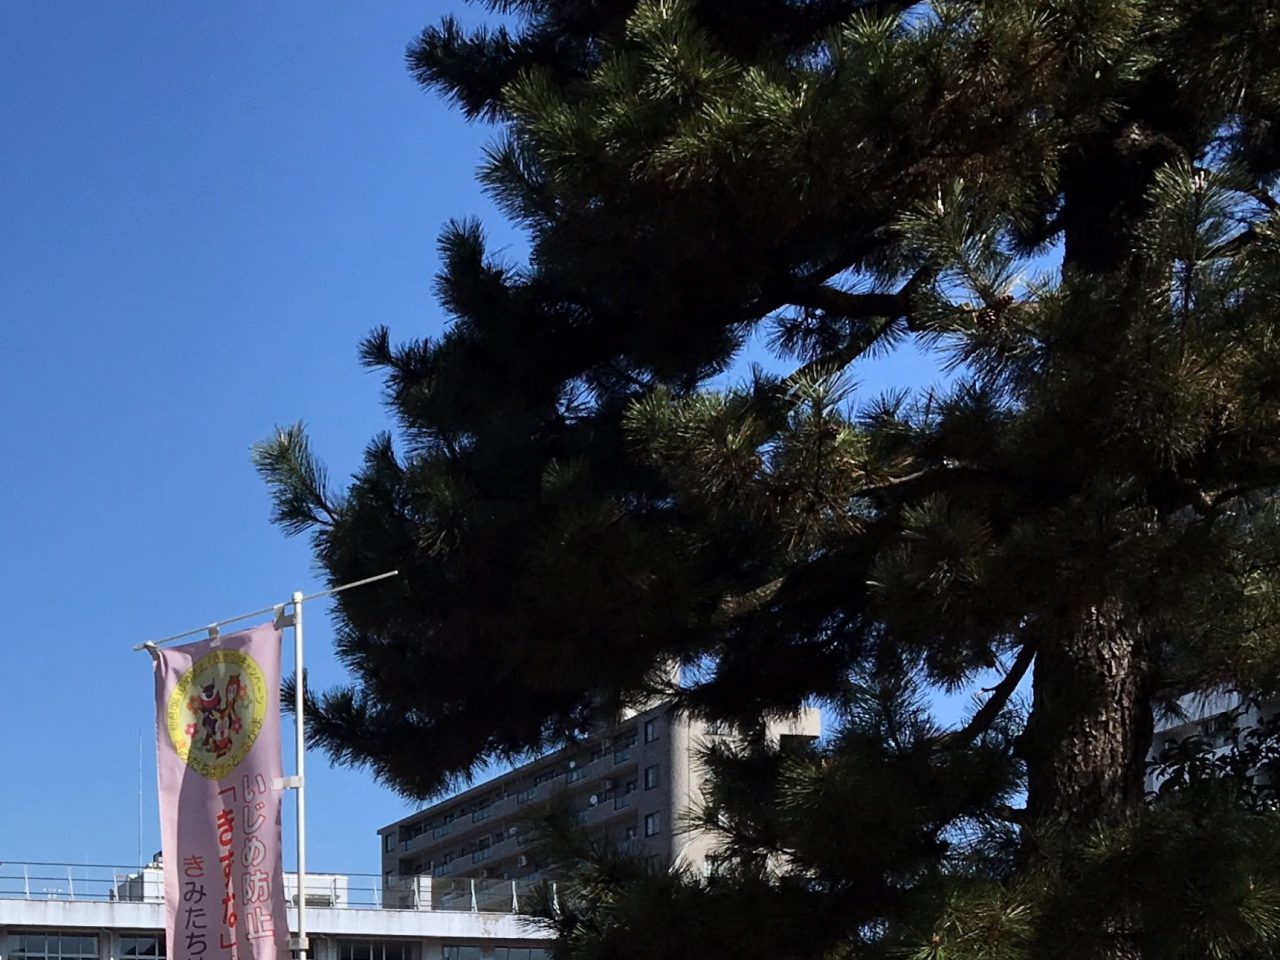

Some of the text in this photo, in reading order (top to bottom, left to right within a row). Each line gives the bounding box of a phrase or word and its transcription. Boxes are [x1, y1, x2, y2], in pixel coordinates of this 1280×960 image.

[241, 773, 275, 941] いじめ防止
